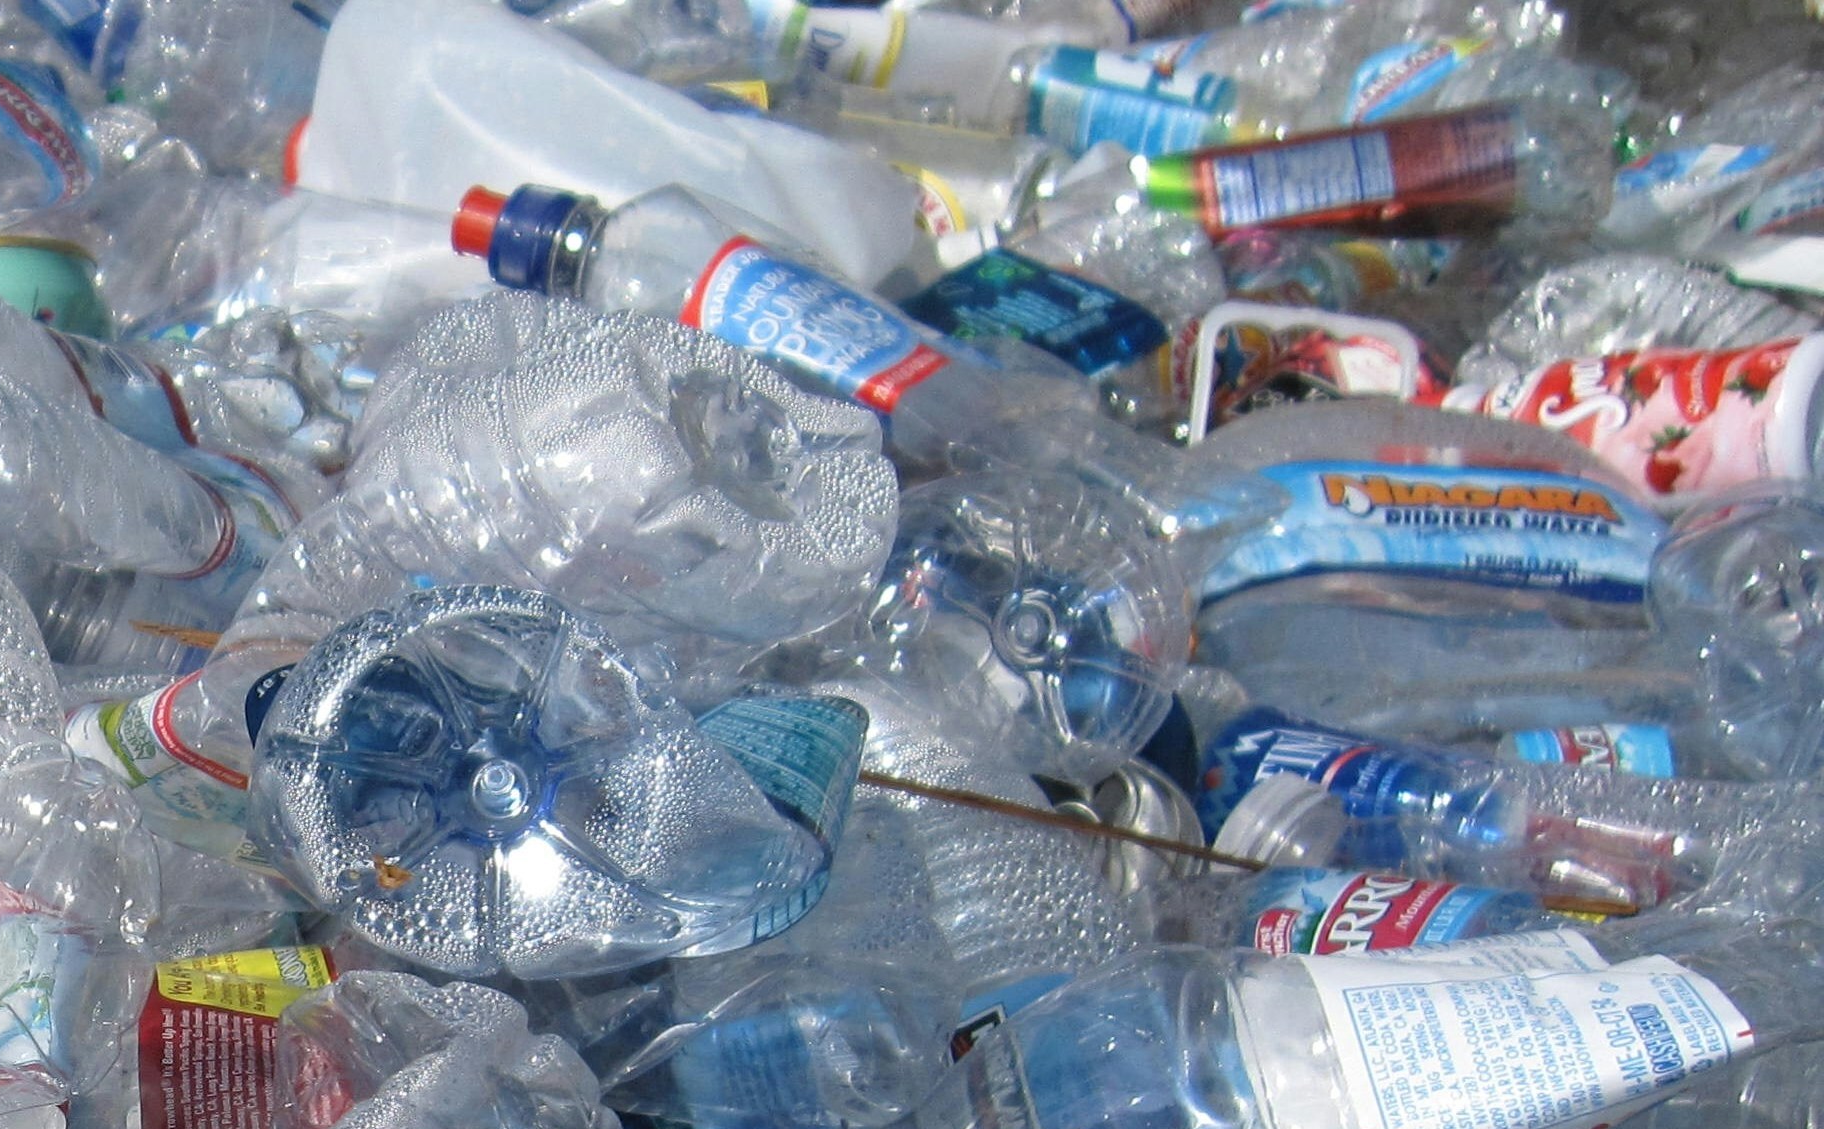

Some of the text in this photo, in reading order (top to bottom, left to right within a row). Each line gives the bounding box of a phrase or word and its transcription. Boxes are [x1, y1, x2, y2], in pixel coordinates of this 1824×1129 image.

[1321, 474, 1624, 526] NIAGARA
[1380, 1024, 1401, 1054] CCDA
[1391, 1058, 1408, 1072] BY
[1426, 1071, 1445, 1091] BIG
